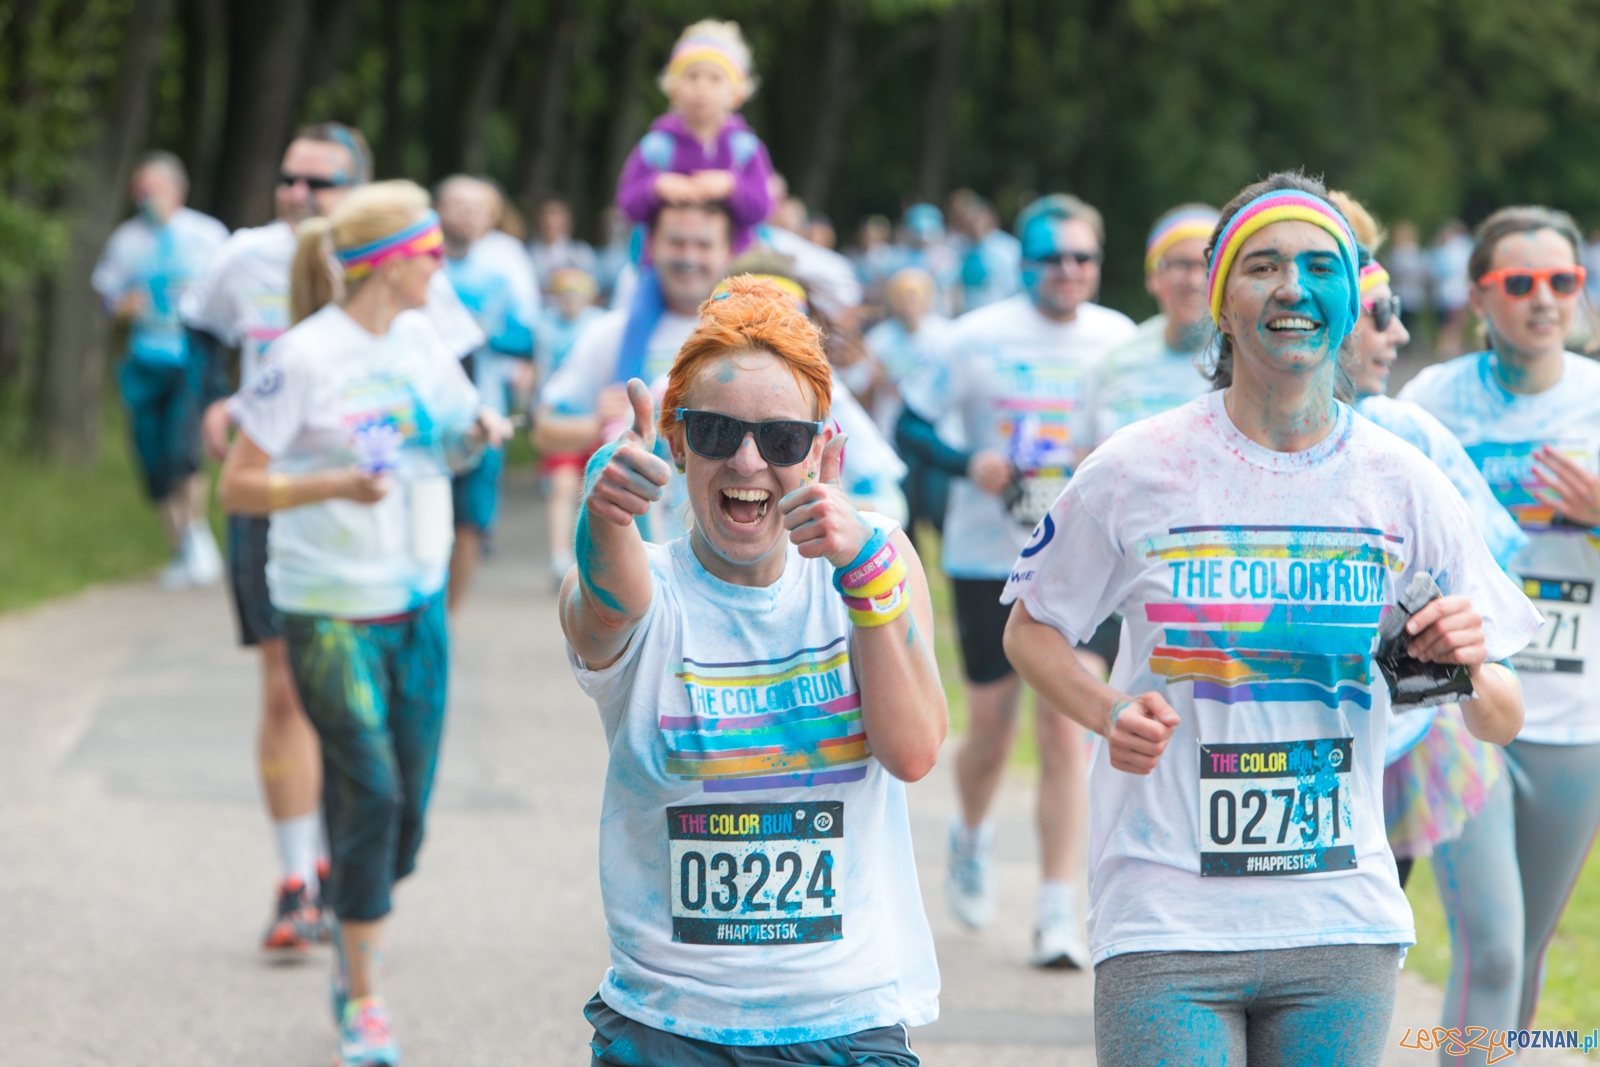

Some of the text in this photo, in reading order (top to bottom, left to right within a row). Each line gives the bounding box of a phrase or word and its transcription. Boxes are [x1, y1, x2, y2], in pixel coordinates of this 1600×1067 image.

[1168, 560, 1223, 598] THE
[1230, 560, 1329, 600] COLOR
[685, 669, 845, 716] THE COLOR RUN
[1210, 753, 1238, 773] THE
[1240, 752, 1288, 773] COLOR
[679, 813, 793, 835] THE COLOR RUN
[1210, 787, 1341, 846] 02791
[680, 850, 836, 912] 03224
[1247, 853, 1318, 872] #HAPPIEST5K
